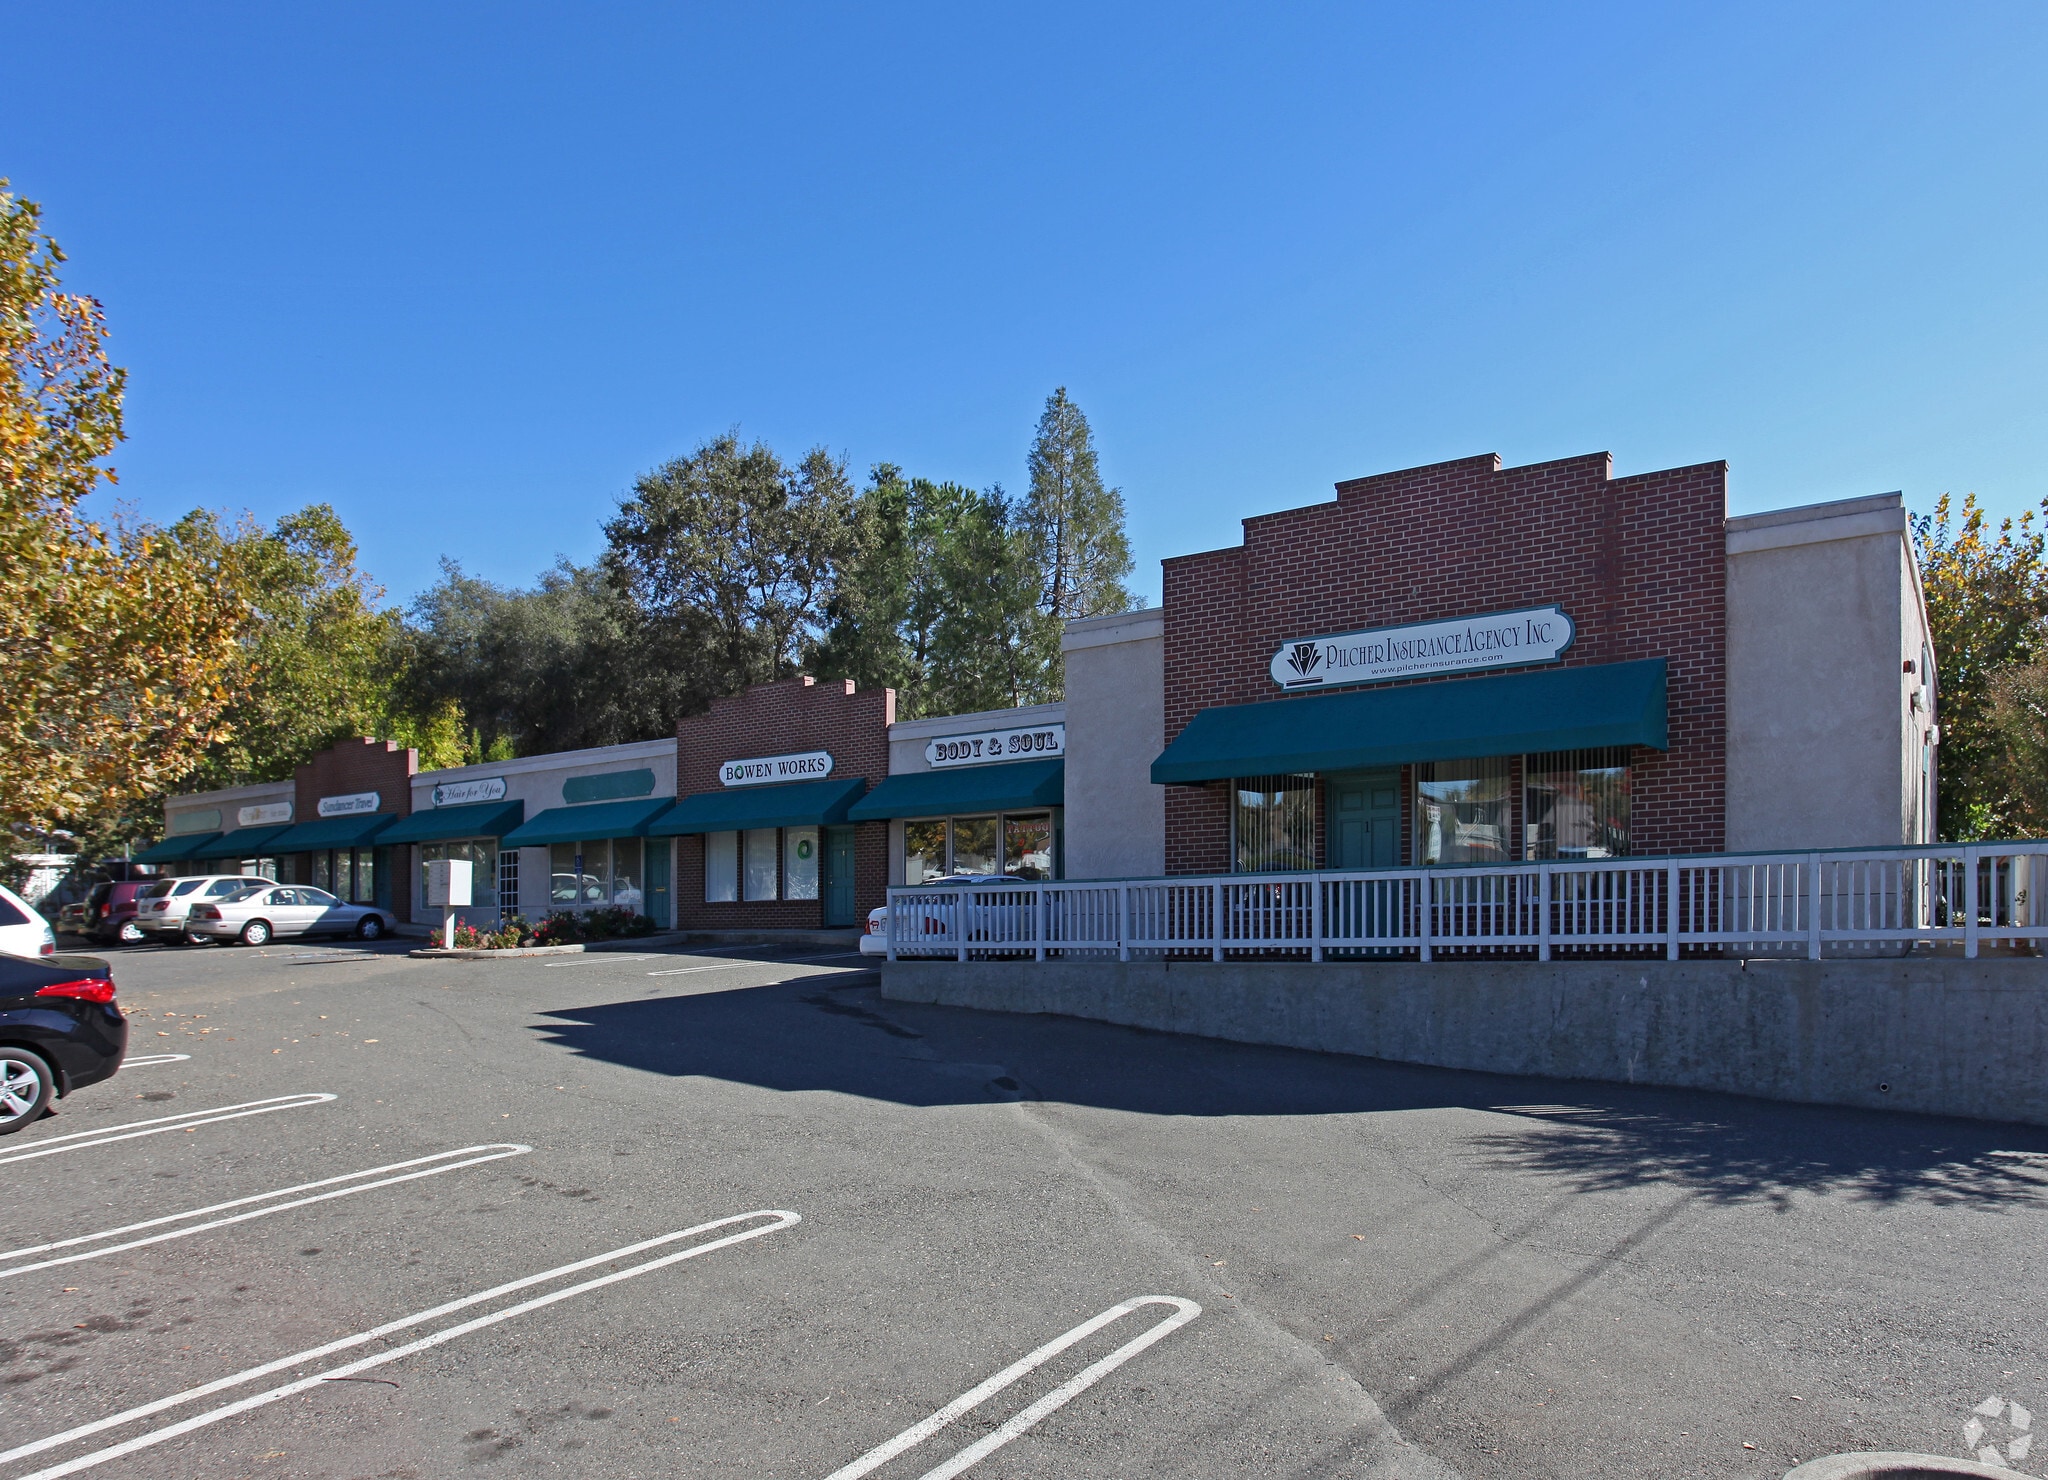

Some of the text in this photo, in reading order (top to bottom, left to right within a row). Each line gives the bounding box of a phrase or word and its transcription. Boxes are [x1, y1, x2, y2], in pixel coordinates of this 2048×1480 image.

[1325, 619, 1554, 669] PILCHER INSURANCE AGENCY INC.
[1370, 654, 1504, 675] www.pilcherinsurance.com
[934, 731, 1058, 761] BODY & SOUL
[725, 758, 826, 780] BOWEN WORKS
[444, 781, 501, 801] Hair for You
[322, 795, 374, 813] Sundancer Travel
[1006, 822, 1050, 834] TATTOO
